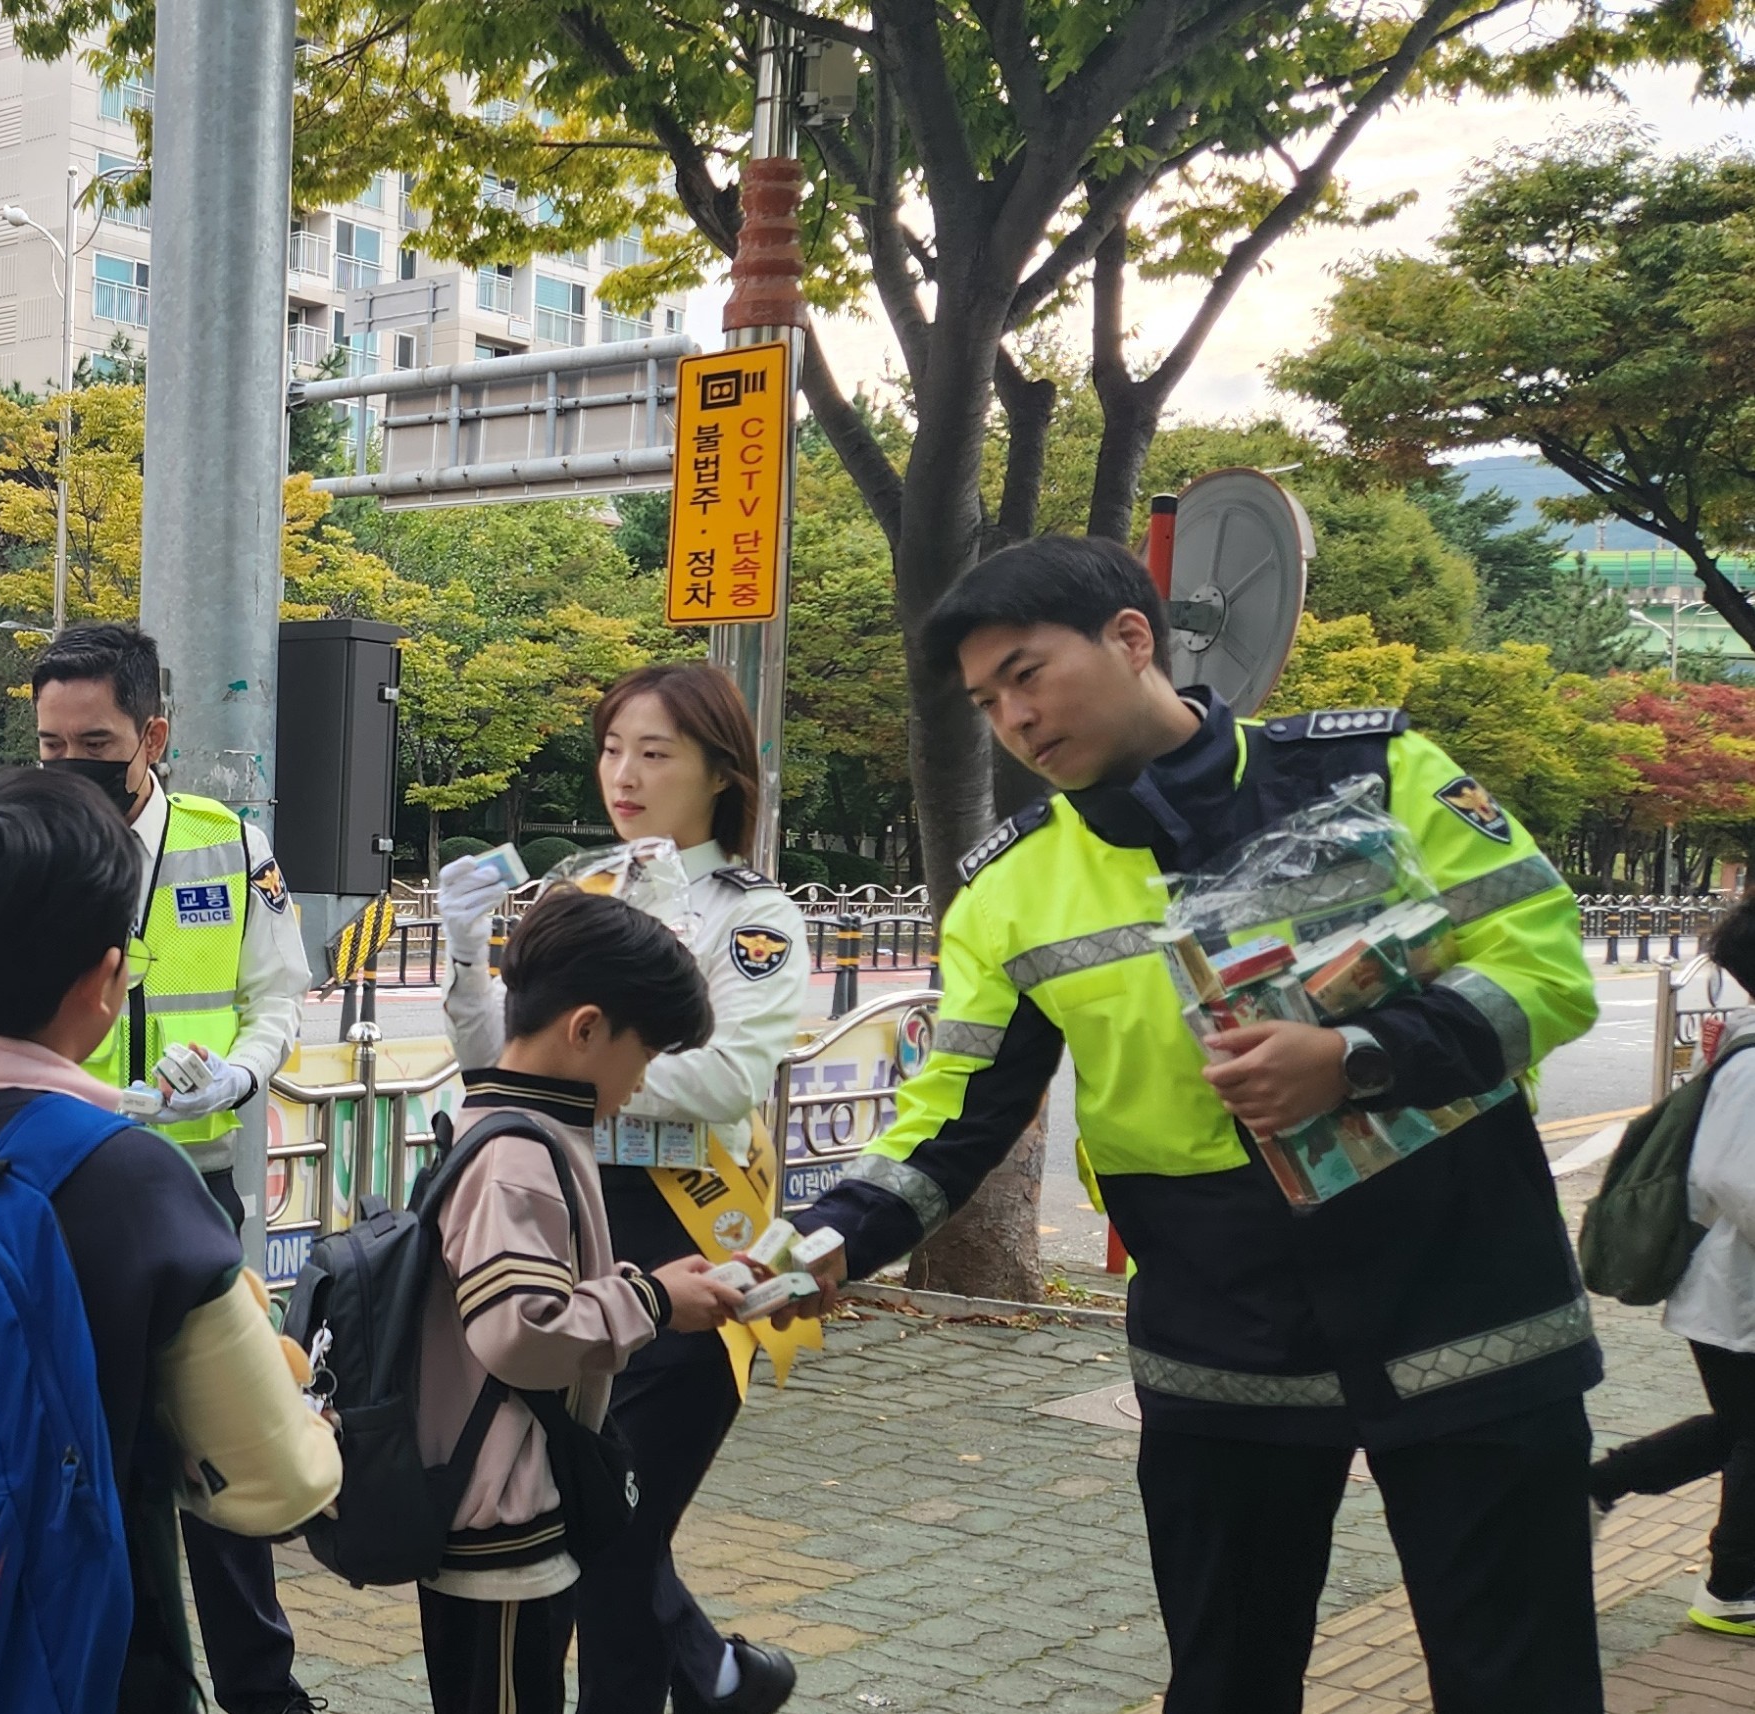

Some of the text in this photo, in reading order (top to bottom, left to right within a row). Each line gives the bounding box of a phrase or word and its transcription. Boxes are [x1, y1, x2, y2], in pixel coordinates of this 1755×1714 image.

[728, 417, 765, 608] CCTV 단속중
[180, 910, 231, 924] POLICE
